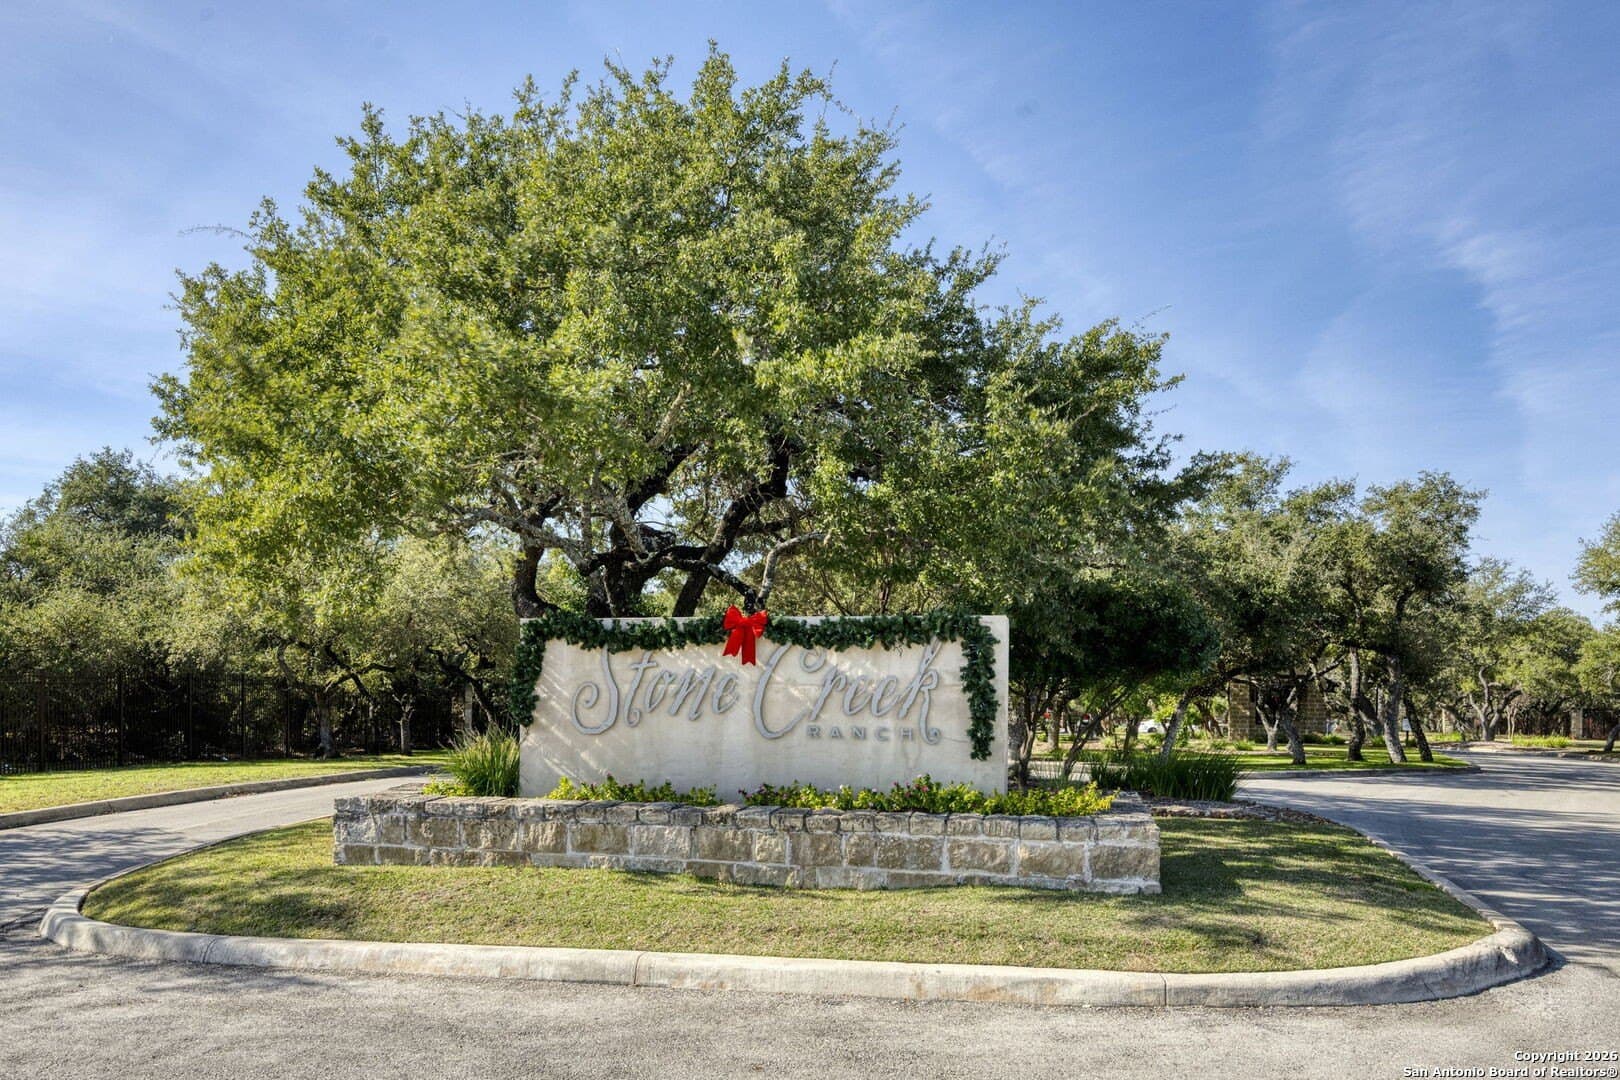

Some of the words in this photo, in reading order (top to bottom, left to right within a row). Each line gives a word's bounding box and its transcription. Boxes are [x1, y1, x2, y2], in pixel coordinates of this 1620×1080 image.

[572, 643, 739, 735] Stone
[753, 637, 941, 745] Creek
[807, 725, 915, 741] RANCH
